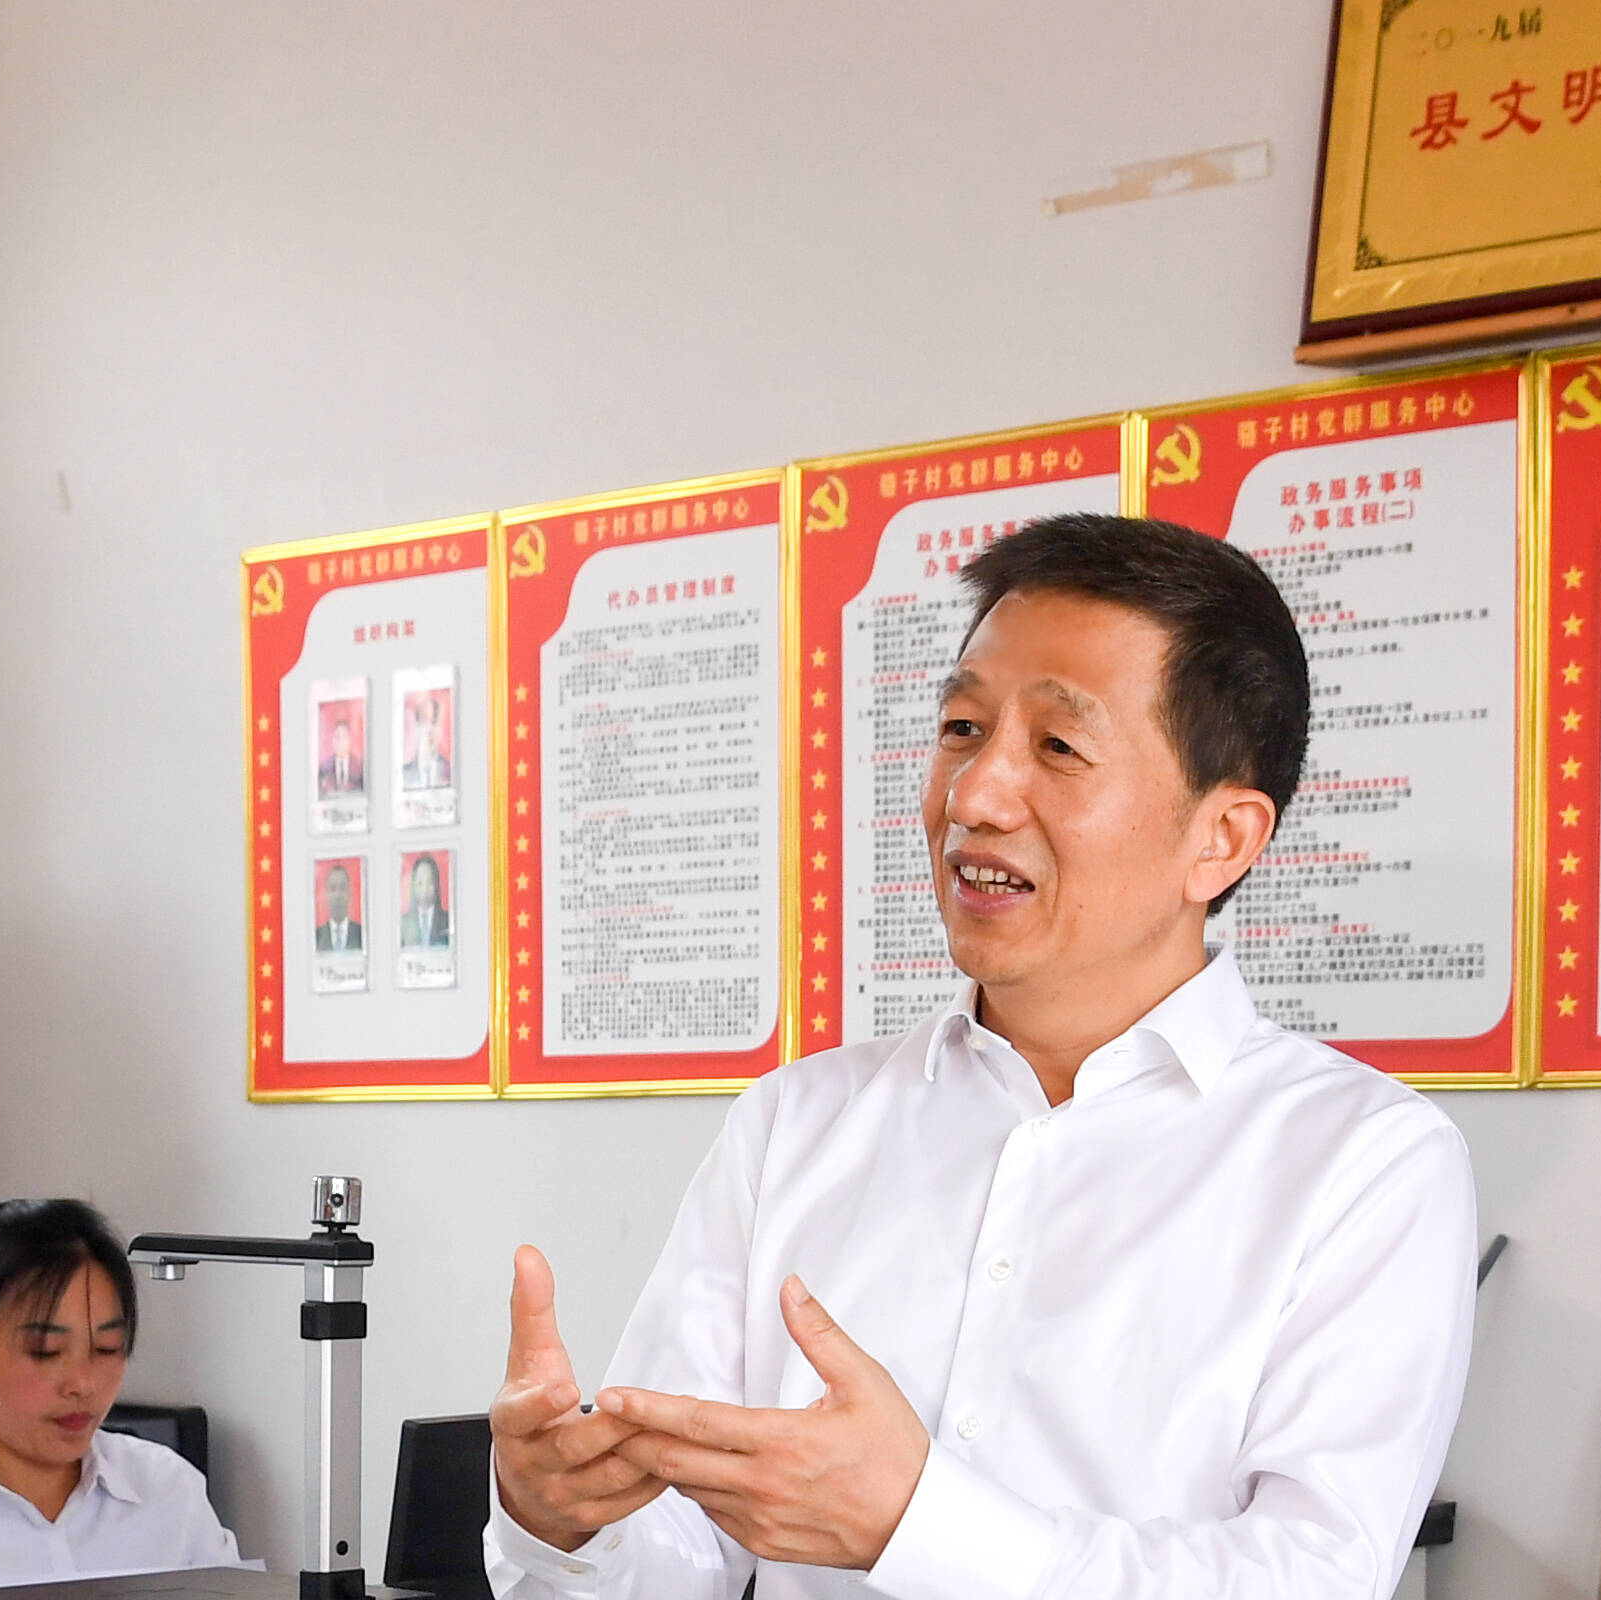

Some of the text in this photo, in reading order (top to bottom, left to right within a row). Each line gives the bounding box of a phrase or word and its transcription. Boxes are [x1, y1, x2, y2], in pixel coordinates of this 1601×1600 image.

[1281, 468, 1422, 506] 政务服务事项
[608, 575, 735, 609] 代办员管理制度
